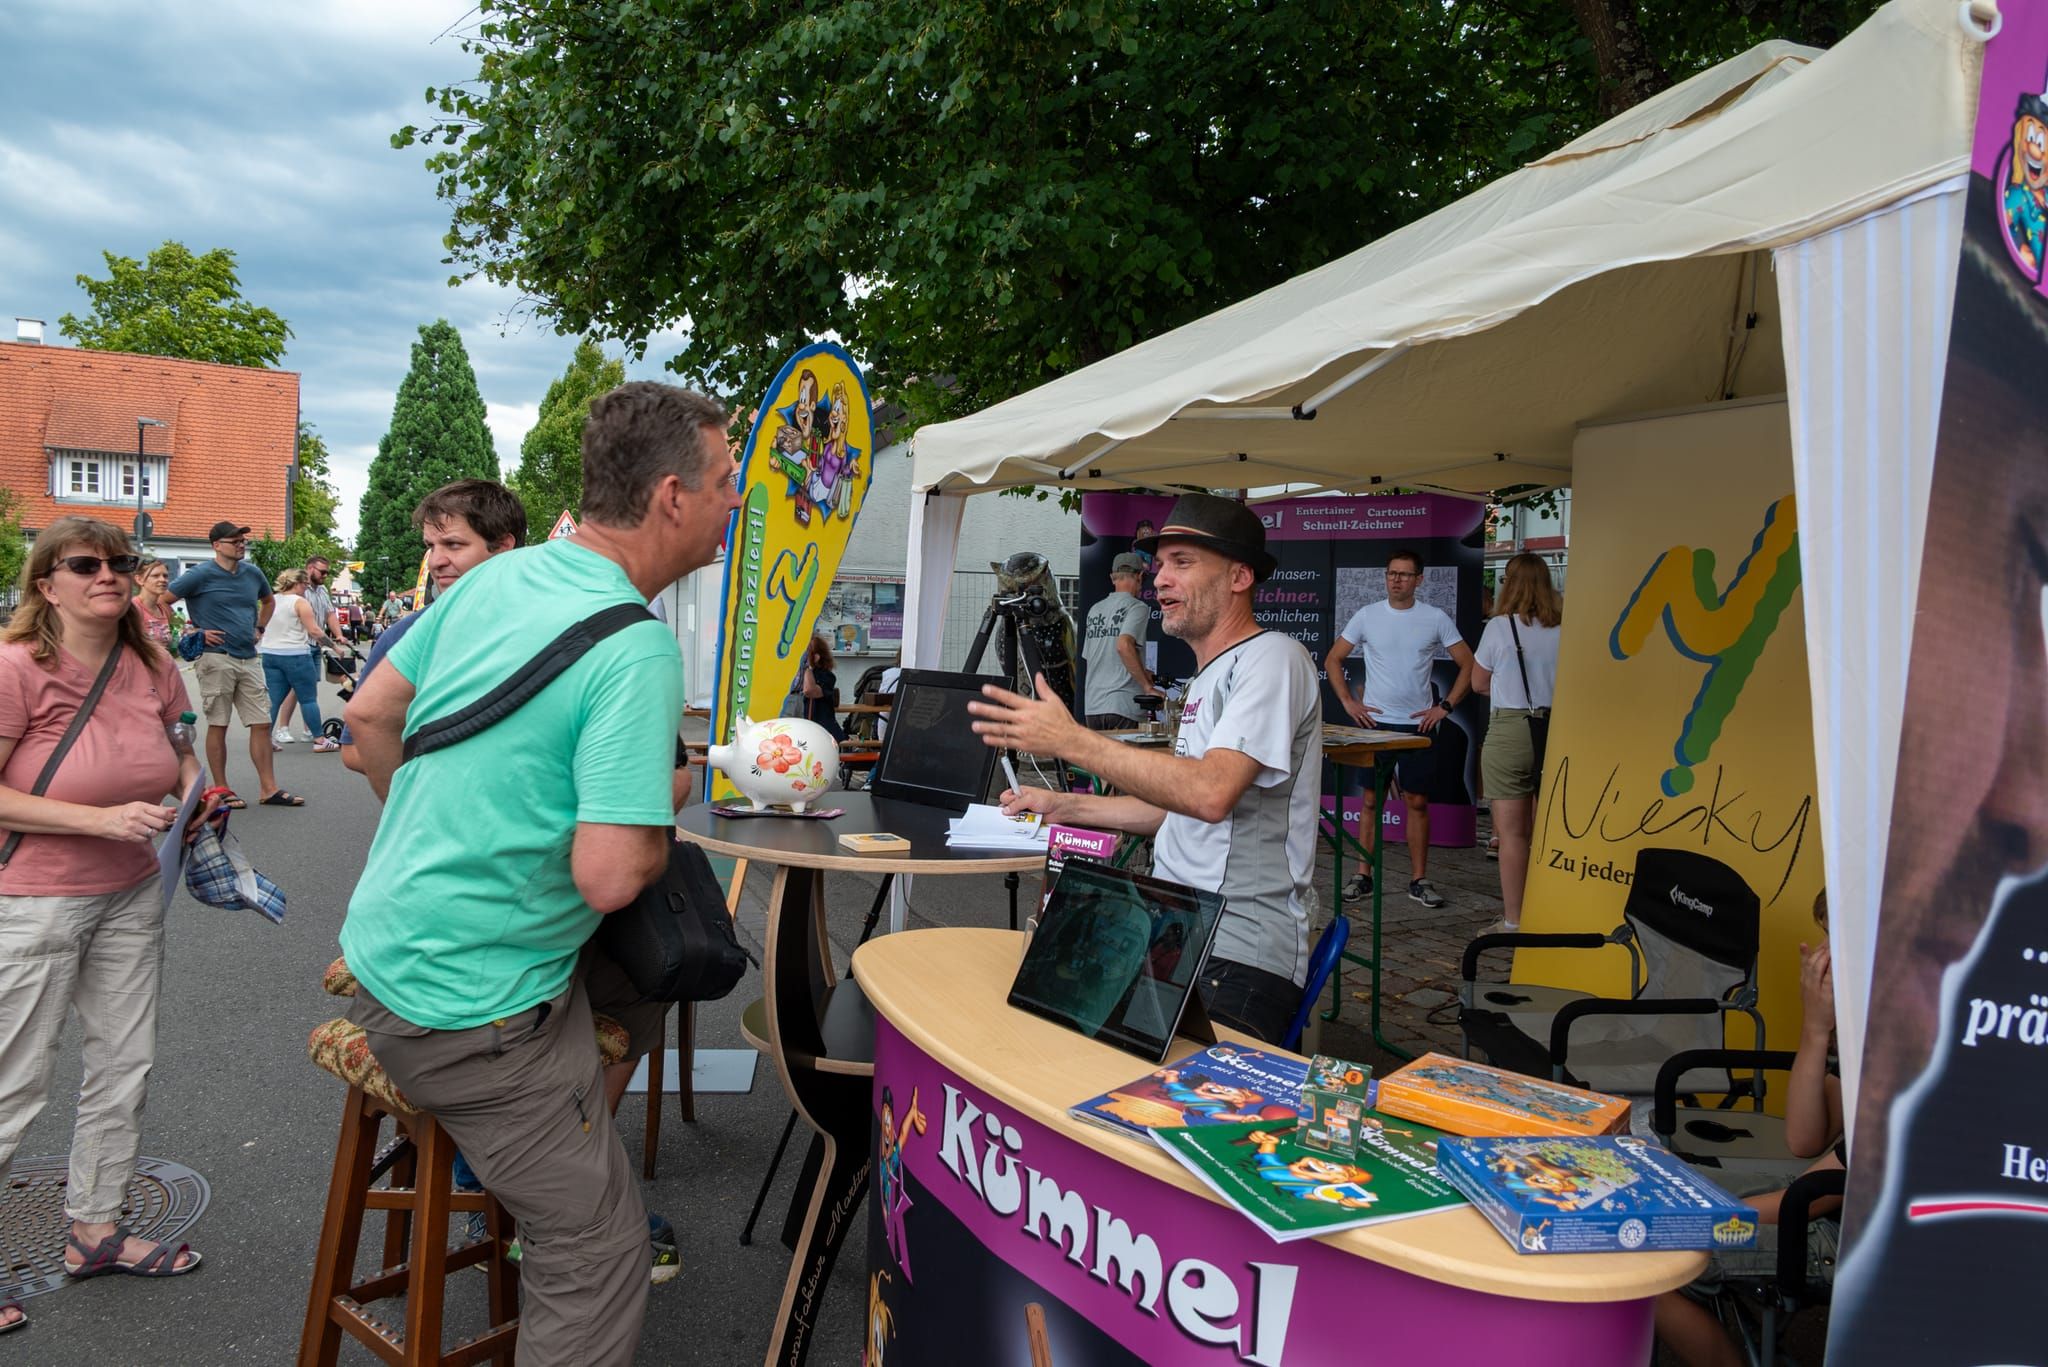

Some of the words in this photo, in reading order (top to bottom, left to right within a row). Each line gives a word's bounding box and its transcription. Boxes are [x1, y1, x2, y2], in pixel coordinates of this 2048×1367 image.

[1296, 506, 1356, 516] Entertainer
[1367, 506, 1427, 517] Cartoonist
[1303, 519, 1405, 531] Schnell-Zeichner
[1268, 568, 1321, 581] lnasen-
[1087, 624, 1121, 639] olfskin
[1055, 831, 1105, 851] Kümmel
[1549, 849, 1576, 873] Zu
[1579, 855, 1635, 886] jeder
[1677, 891, 1714, 918] KingCamp
[1961, 994, 2048, 1047] prä
[938, 1083, 1299, 1367] Kümmel
[789, 1255, 826, 1367] anufaktur
